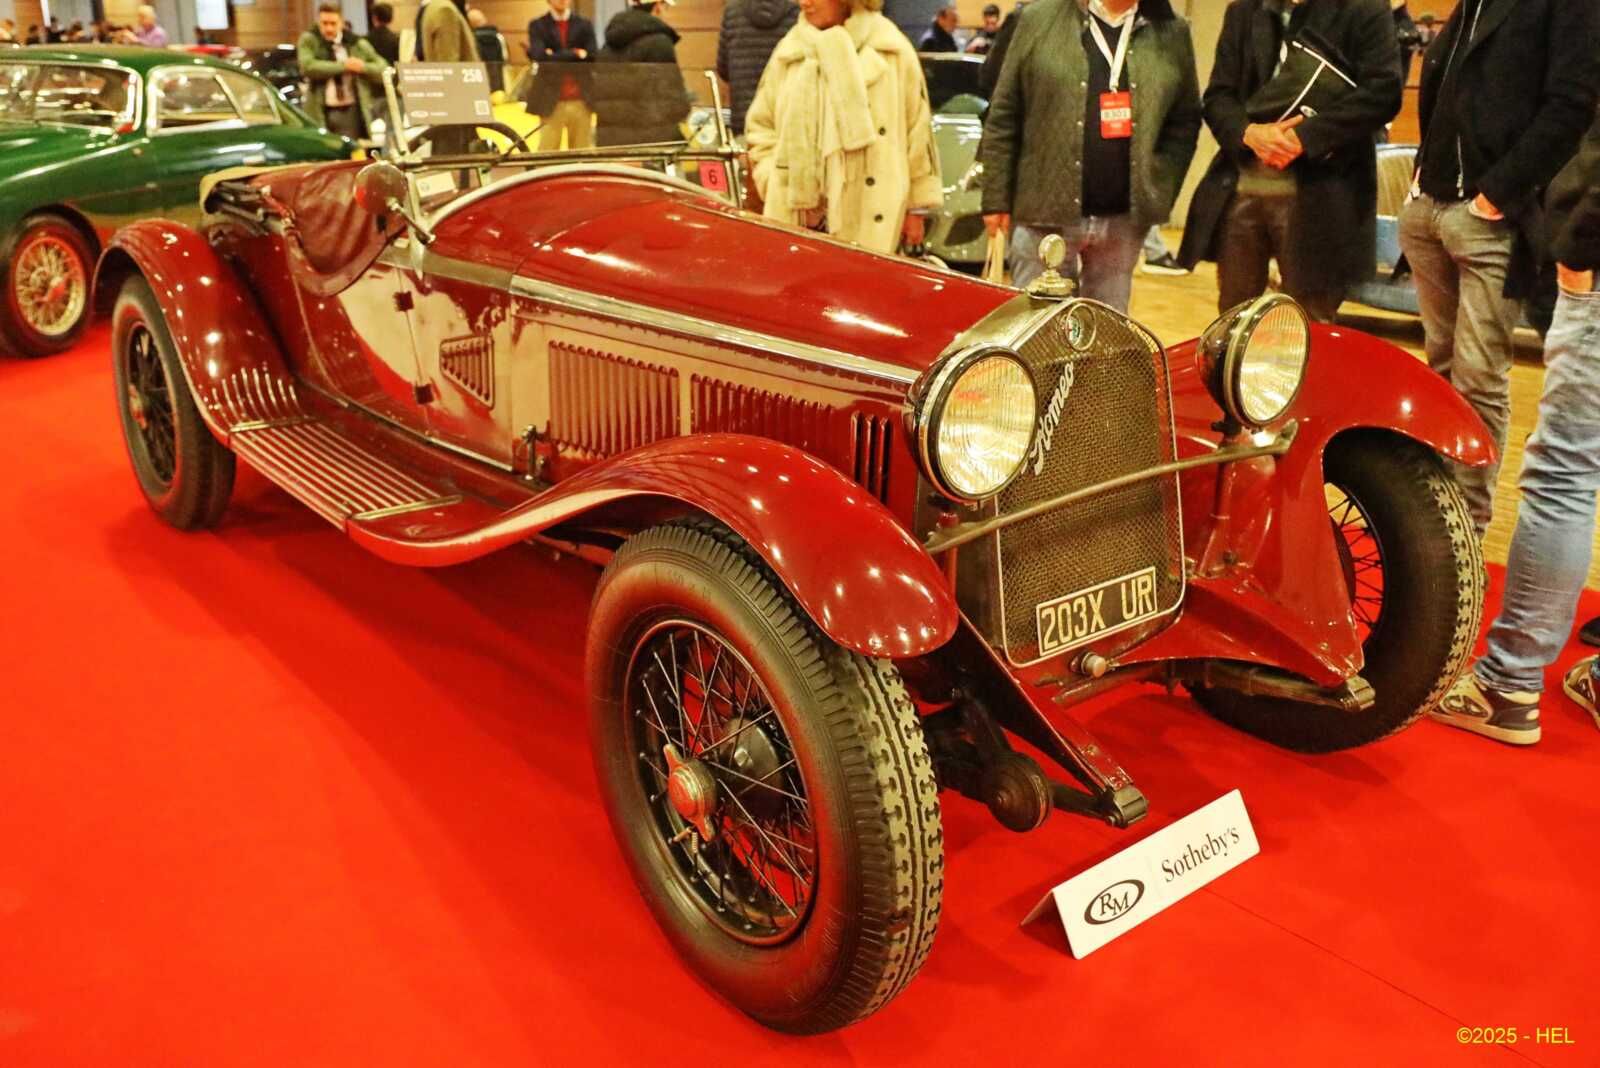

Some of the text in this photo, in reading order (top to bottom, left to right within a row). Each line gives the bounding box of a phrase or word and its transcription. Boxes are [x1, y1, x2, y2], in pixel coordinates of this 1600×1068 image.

[708, 168, 718, 186] 6
[1030, 361, 1074, 476] Romeo
[1041, 574, 1153, 650] 203X UR
[1099, 826, 1241, 917] RM Sotheby's
